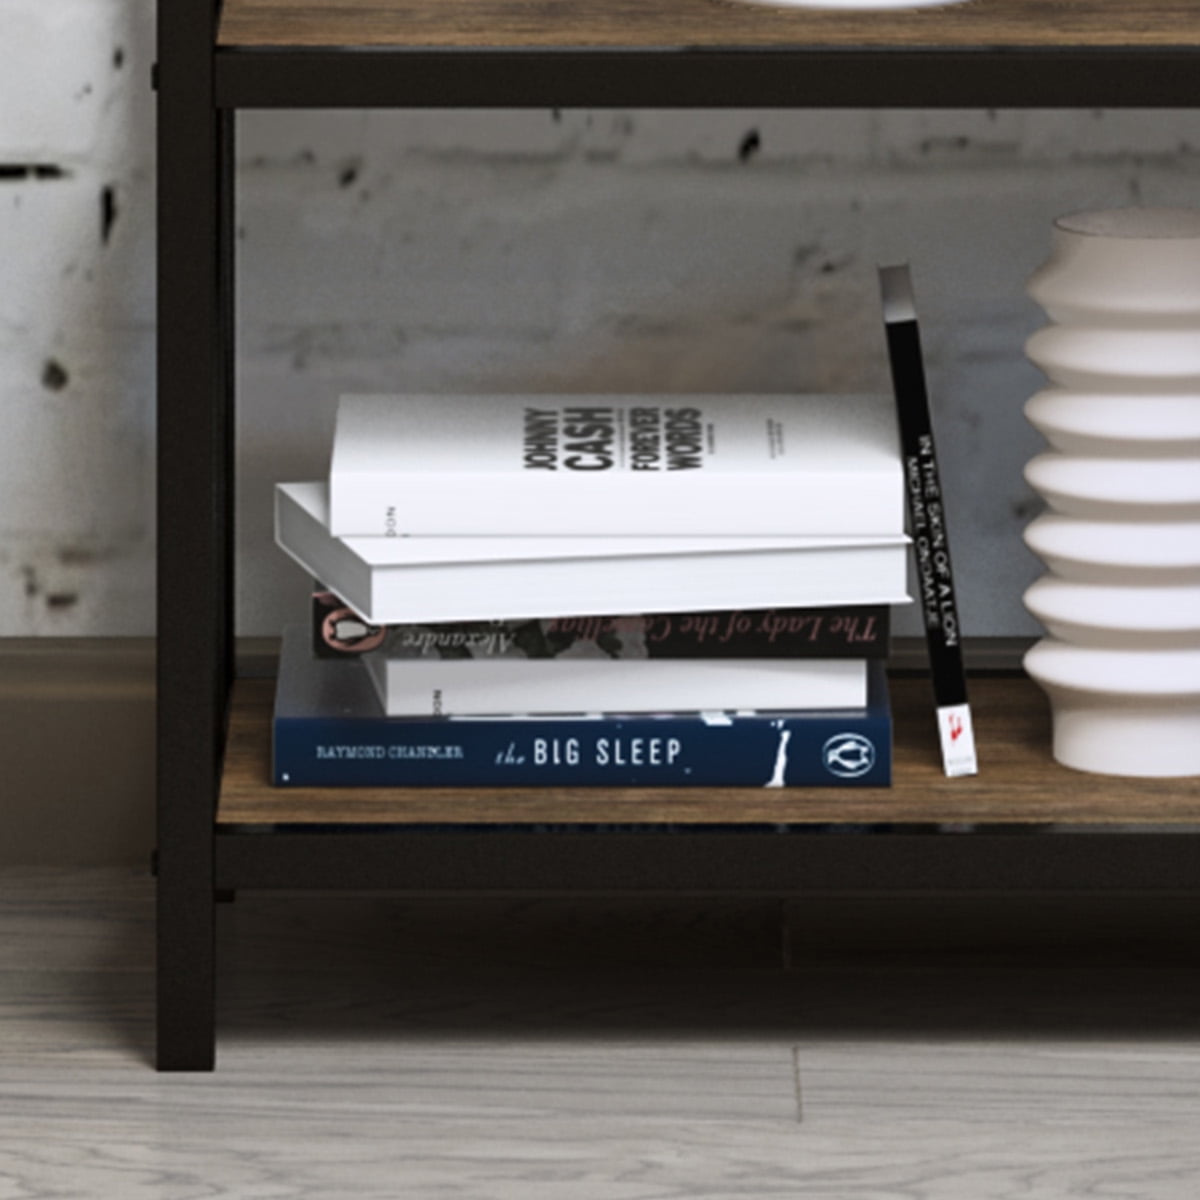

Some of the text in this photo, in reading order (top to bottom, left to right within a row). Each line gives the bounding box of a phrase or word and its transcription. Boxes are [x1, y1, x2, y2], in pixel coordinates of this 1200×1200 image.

[523, 407, 558, 471] JOHNNY
[563, 407, 615, 471] CASH
[630, 407, 660, 471] FOREVER
[664, 407, 702, 471] WORDS
[908, 459, 926, 530] MICHAEL
[918, 435, 959, 647] IN THE SKIN OF A LION
[678, 616, 719, 641] the
[720, 612, 752, 641] of
[756, 610, 823, 641] Lady
[828, 615, 877, 641] The
[401, 631, 515, 654] Alexandre
[316, 746, 463, 759] RAYMOND CHANDLER
[495, 738, 681, 765] the BIG SLEEP
